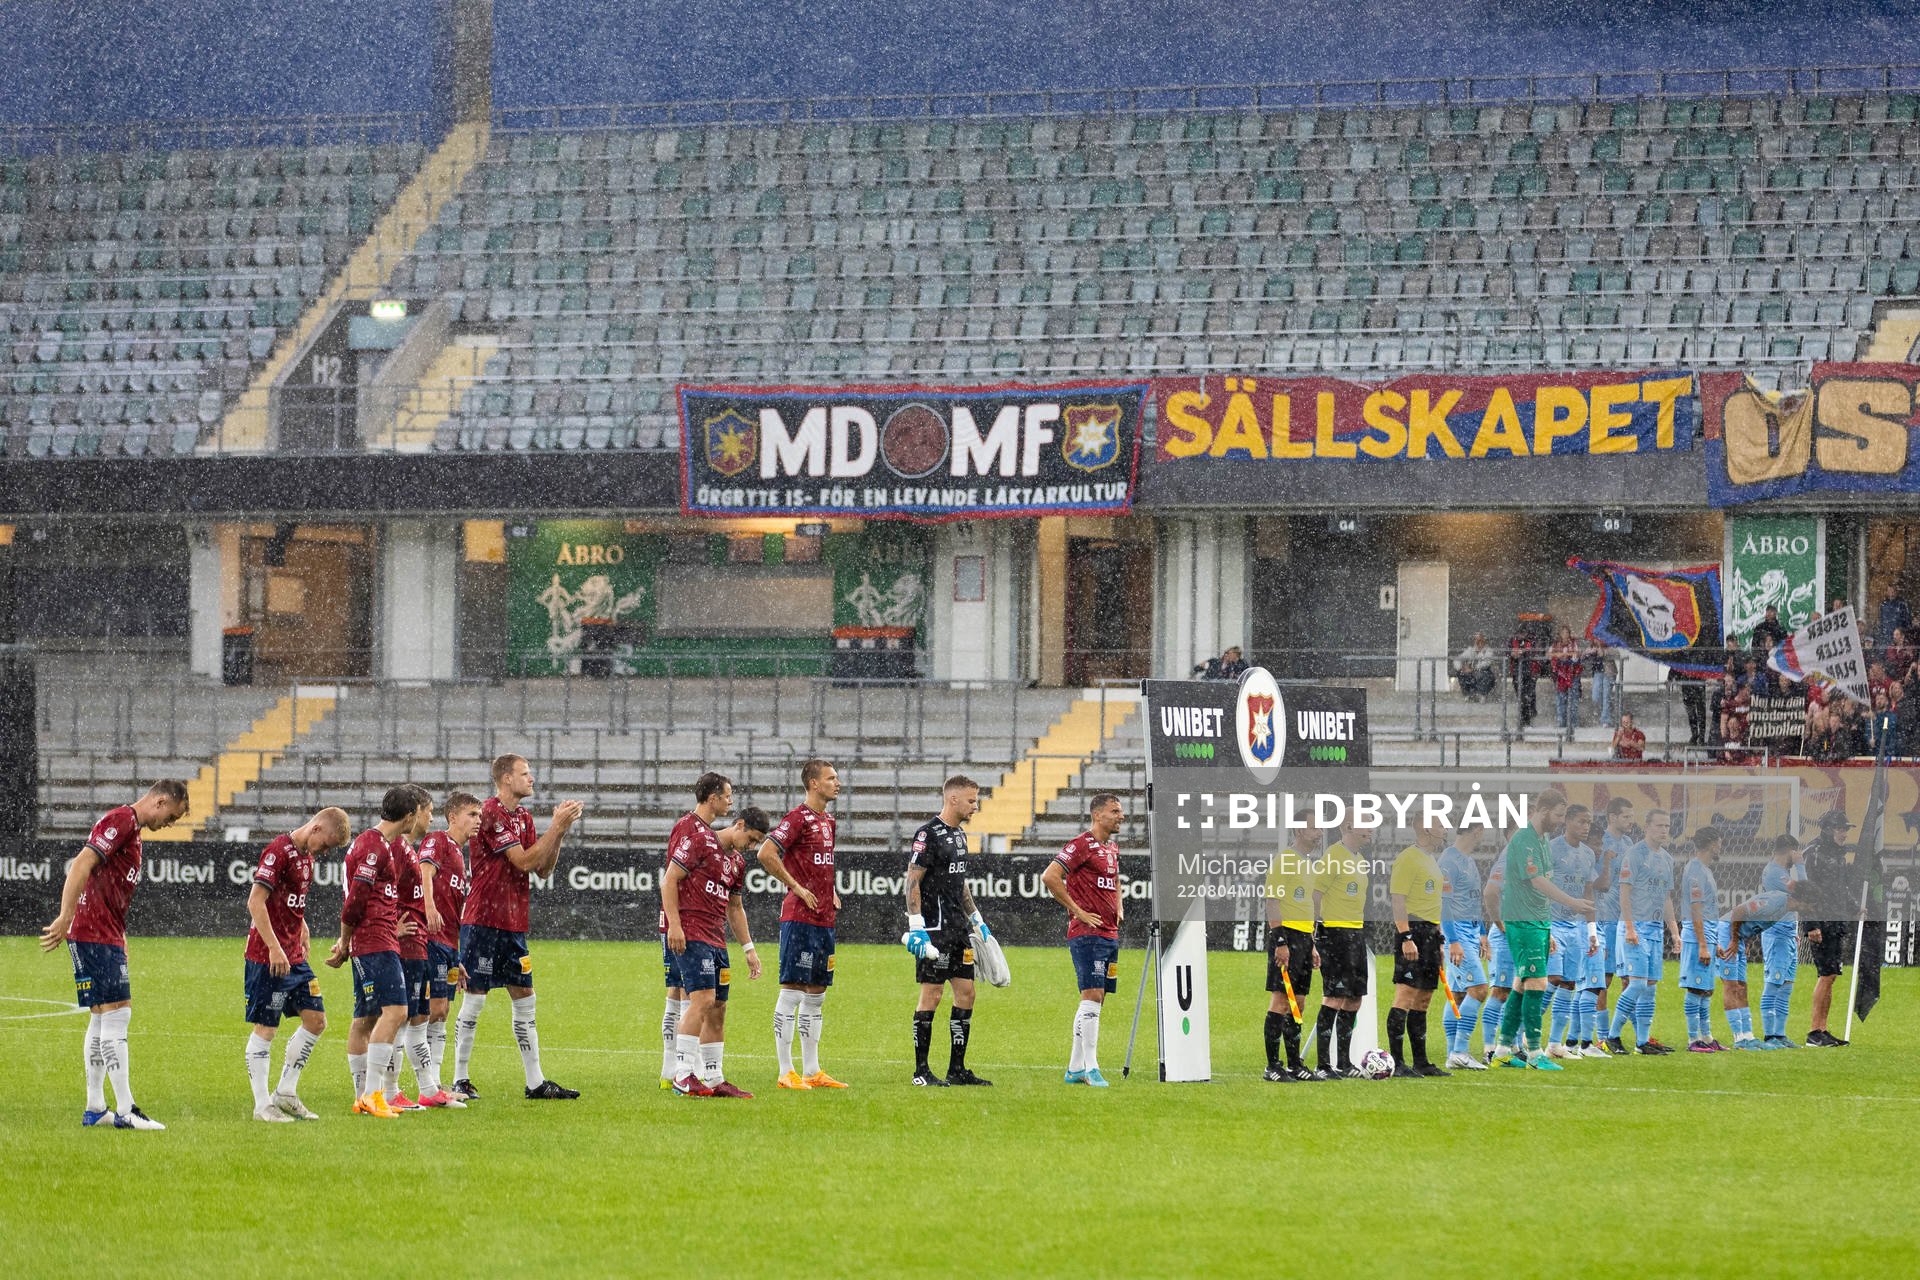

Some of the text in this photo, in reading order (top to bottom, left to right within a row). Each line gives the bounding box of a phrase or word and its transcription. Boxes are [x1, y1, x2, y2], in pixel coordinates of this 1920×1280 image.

[312, 354, 342, 386] H2
[1164, 375, 1693, 461] SÄLLSKAPET
[759, 403, 1061, 480] MD MF
[820, 485, 855, 507] FÖR
[864, 488, 887, 507] EN
[894, 487, 977, 506] LEVANDE
[1161, 707, 1224, 738] UNIBET
[1297, 711, 1356, 741] UNIBET
[1749, 720, 1805, 738] fotbollen
[147, 859, 215, 883] Ullevi
[568, 865, 651, 891] Gamla
[836, 870, 908, 896] Ullevi
[1884, 900, 1904, 964] SELECT
[1176, 964, 1193, 1012] U
[513, 1020, 531, 1052] MIKE
[663, 1012, 676, 1041] MIKE
[798, 1013, 811, 1038] MIKE
[950, 1019, 964, 1046] MIKE
[100, 1039, 121, 1073] MIKE
[293, 1040, 317, 1071] MIKE
[412, 1042, 431, 1069] MIKE
